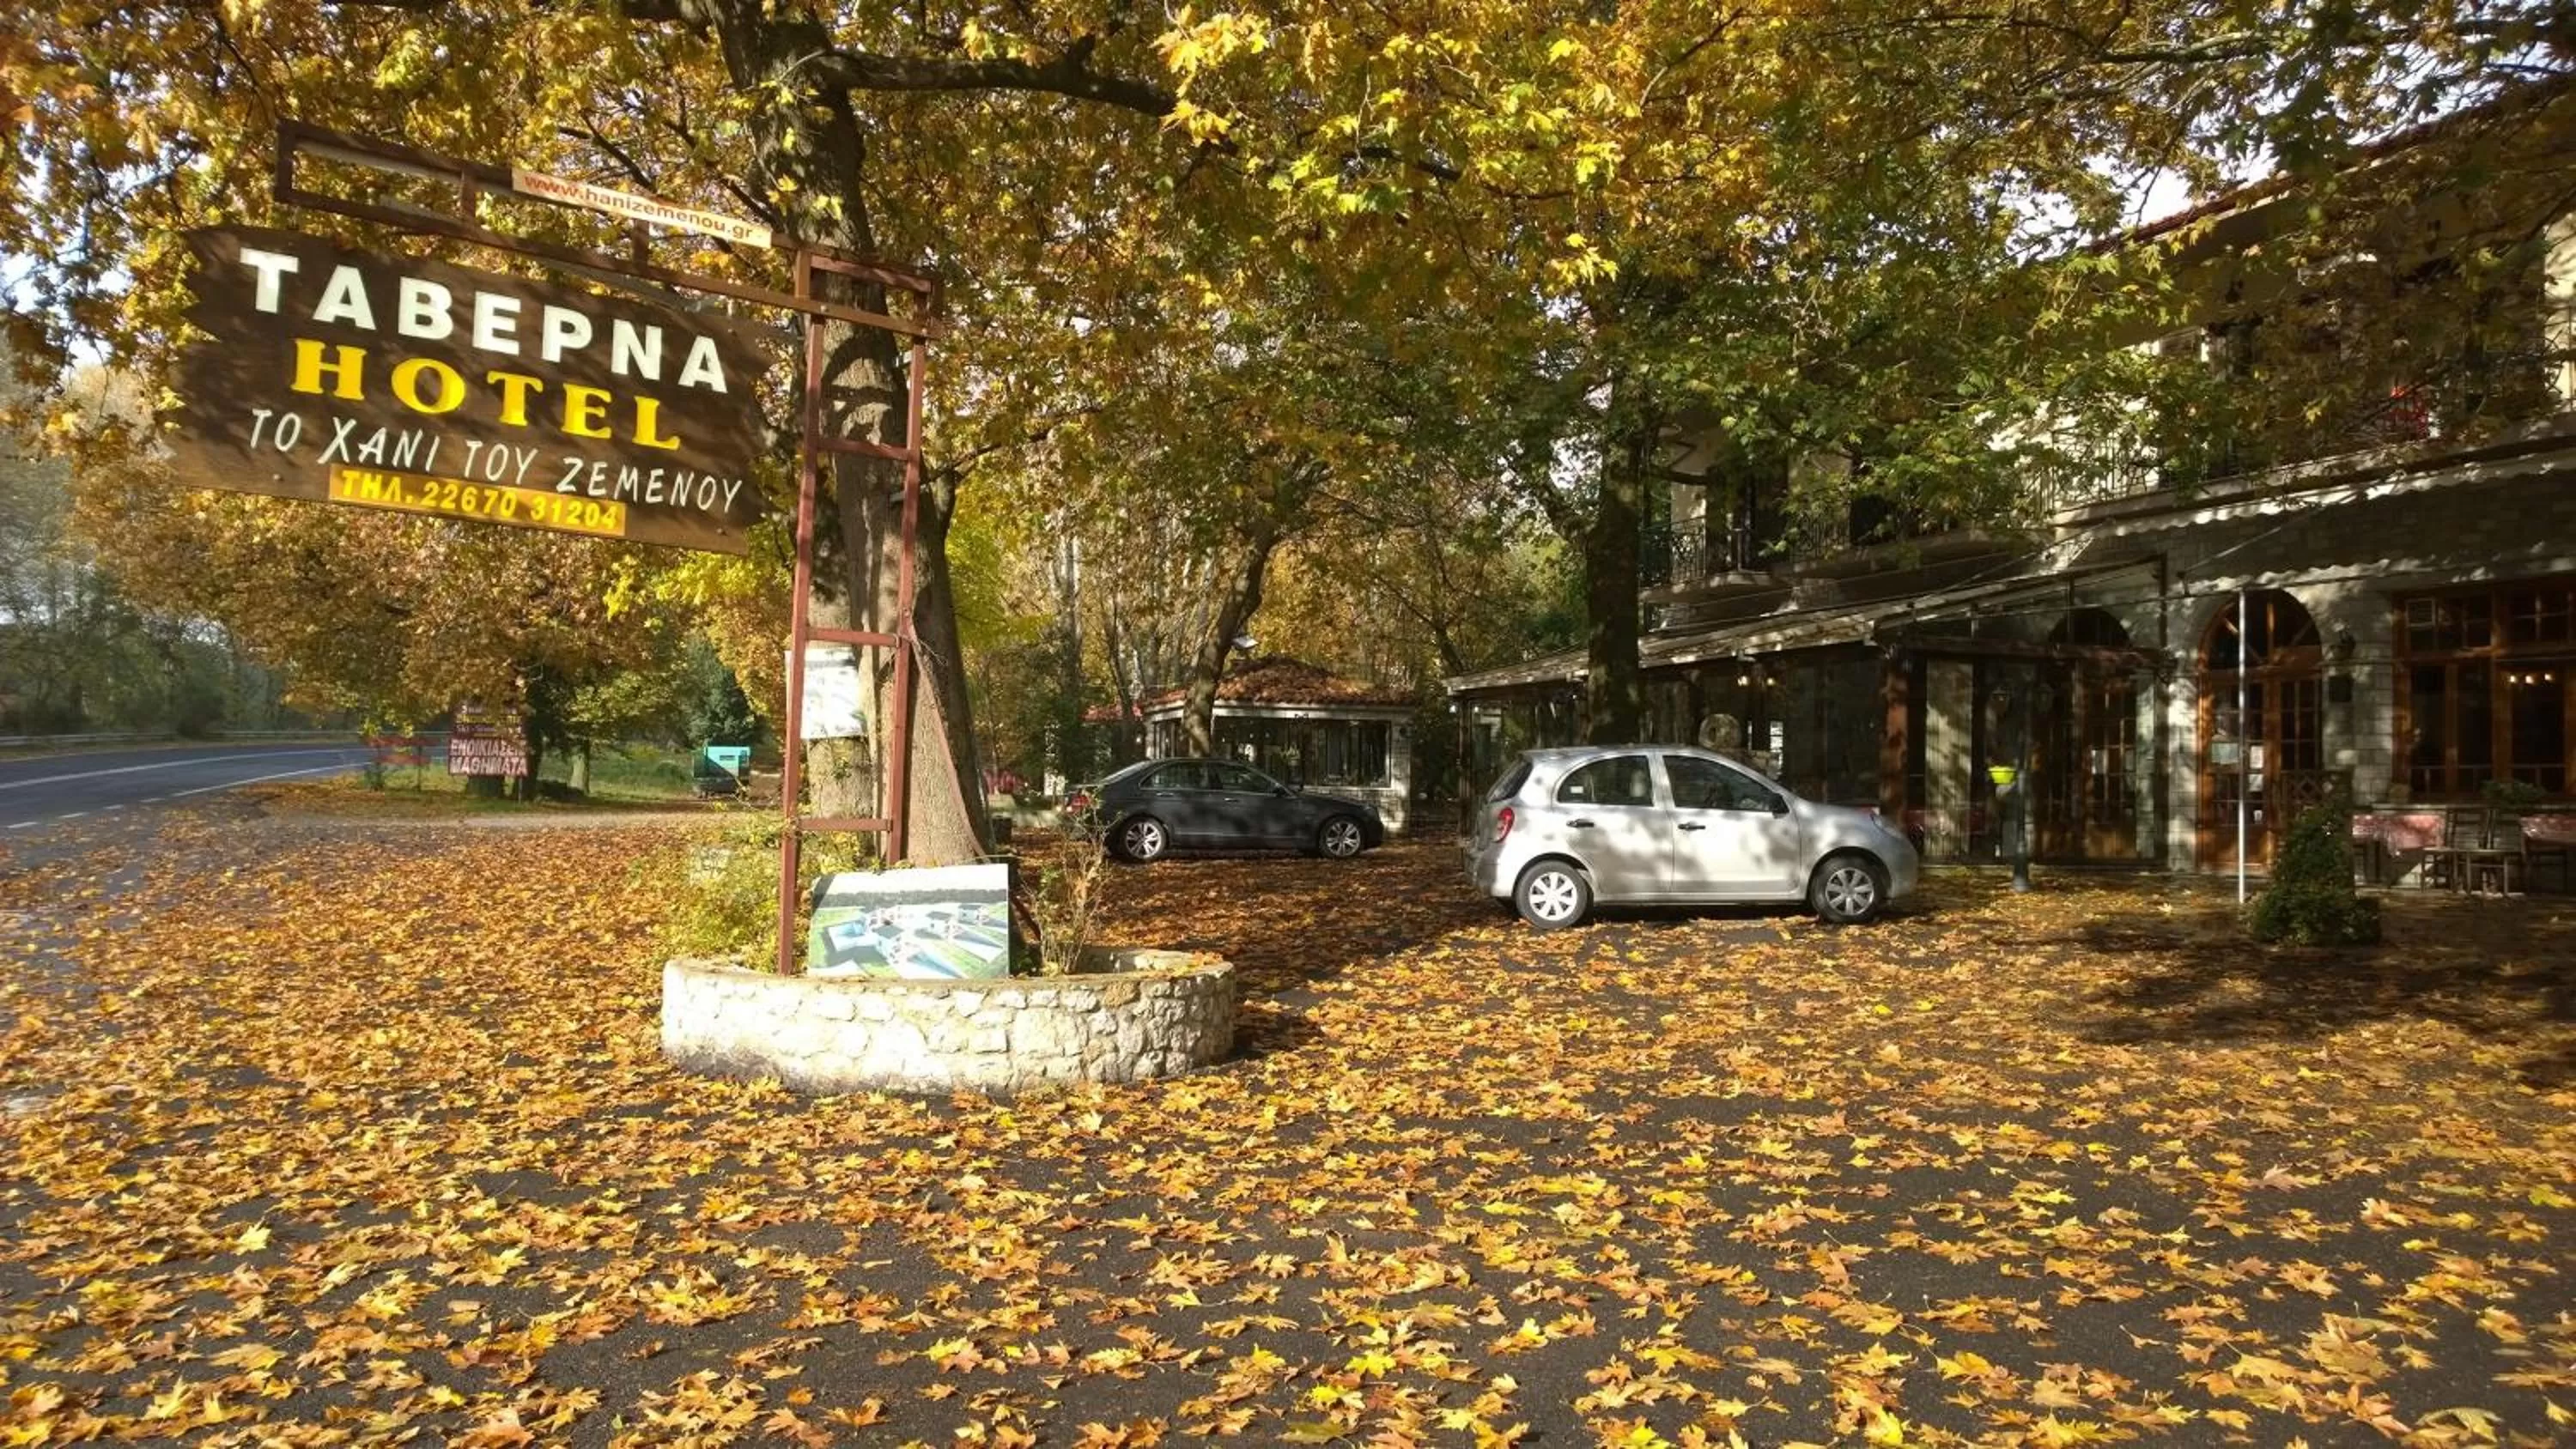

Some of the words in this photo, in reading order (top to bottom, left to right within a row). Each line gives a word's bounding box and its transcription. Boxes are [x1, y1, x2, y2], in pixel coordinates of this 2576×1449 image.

[522, 174, 753, 239] www.hanizemenou.gr
[240, 248, 728, 394] ΤΑΒΕΡΝΑ
[290, 339, 681, 452] HOTEL
[251, 409, 301, 452] ΤΟ
[317, 416, 440, 472] ΧΑΝΙ
[465, 440, 538, 485] ΤΟΥ
[556, 457, 742, 512] ΖΕΜΕΝΟΥ
[342, 470, 414, 504] ΤΗΛ.
[419, 481, 517, 518] 22670
[530, 495, 618, 530] 31204
